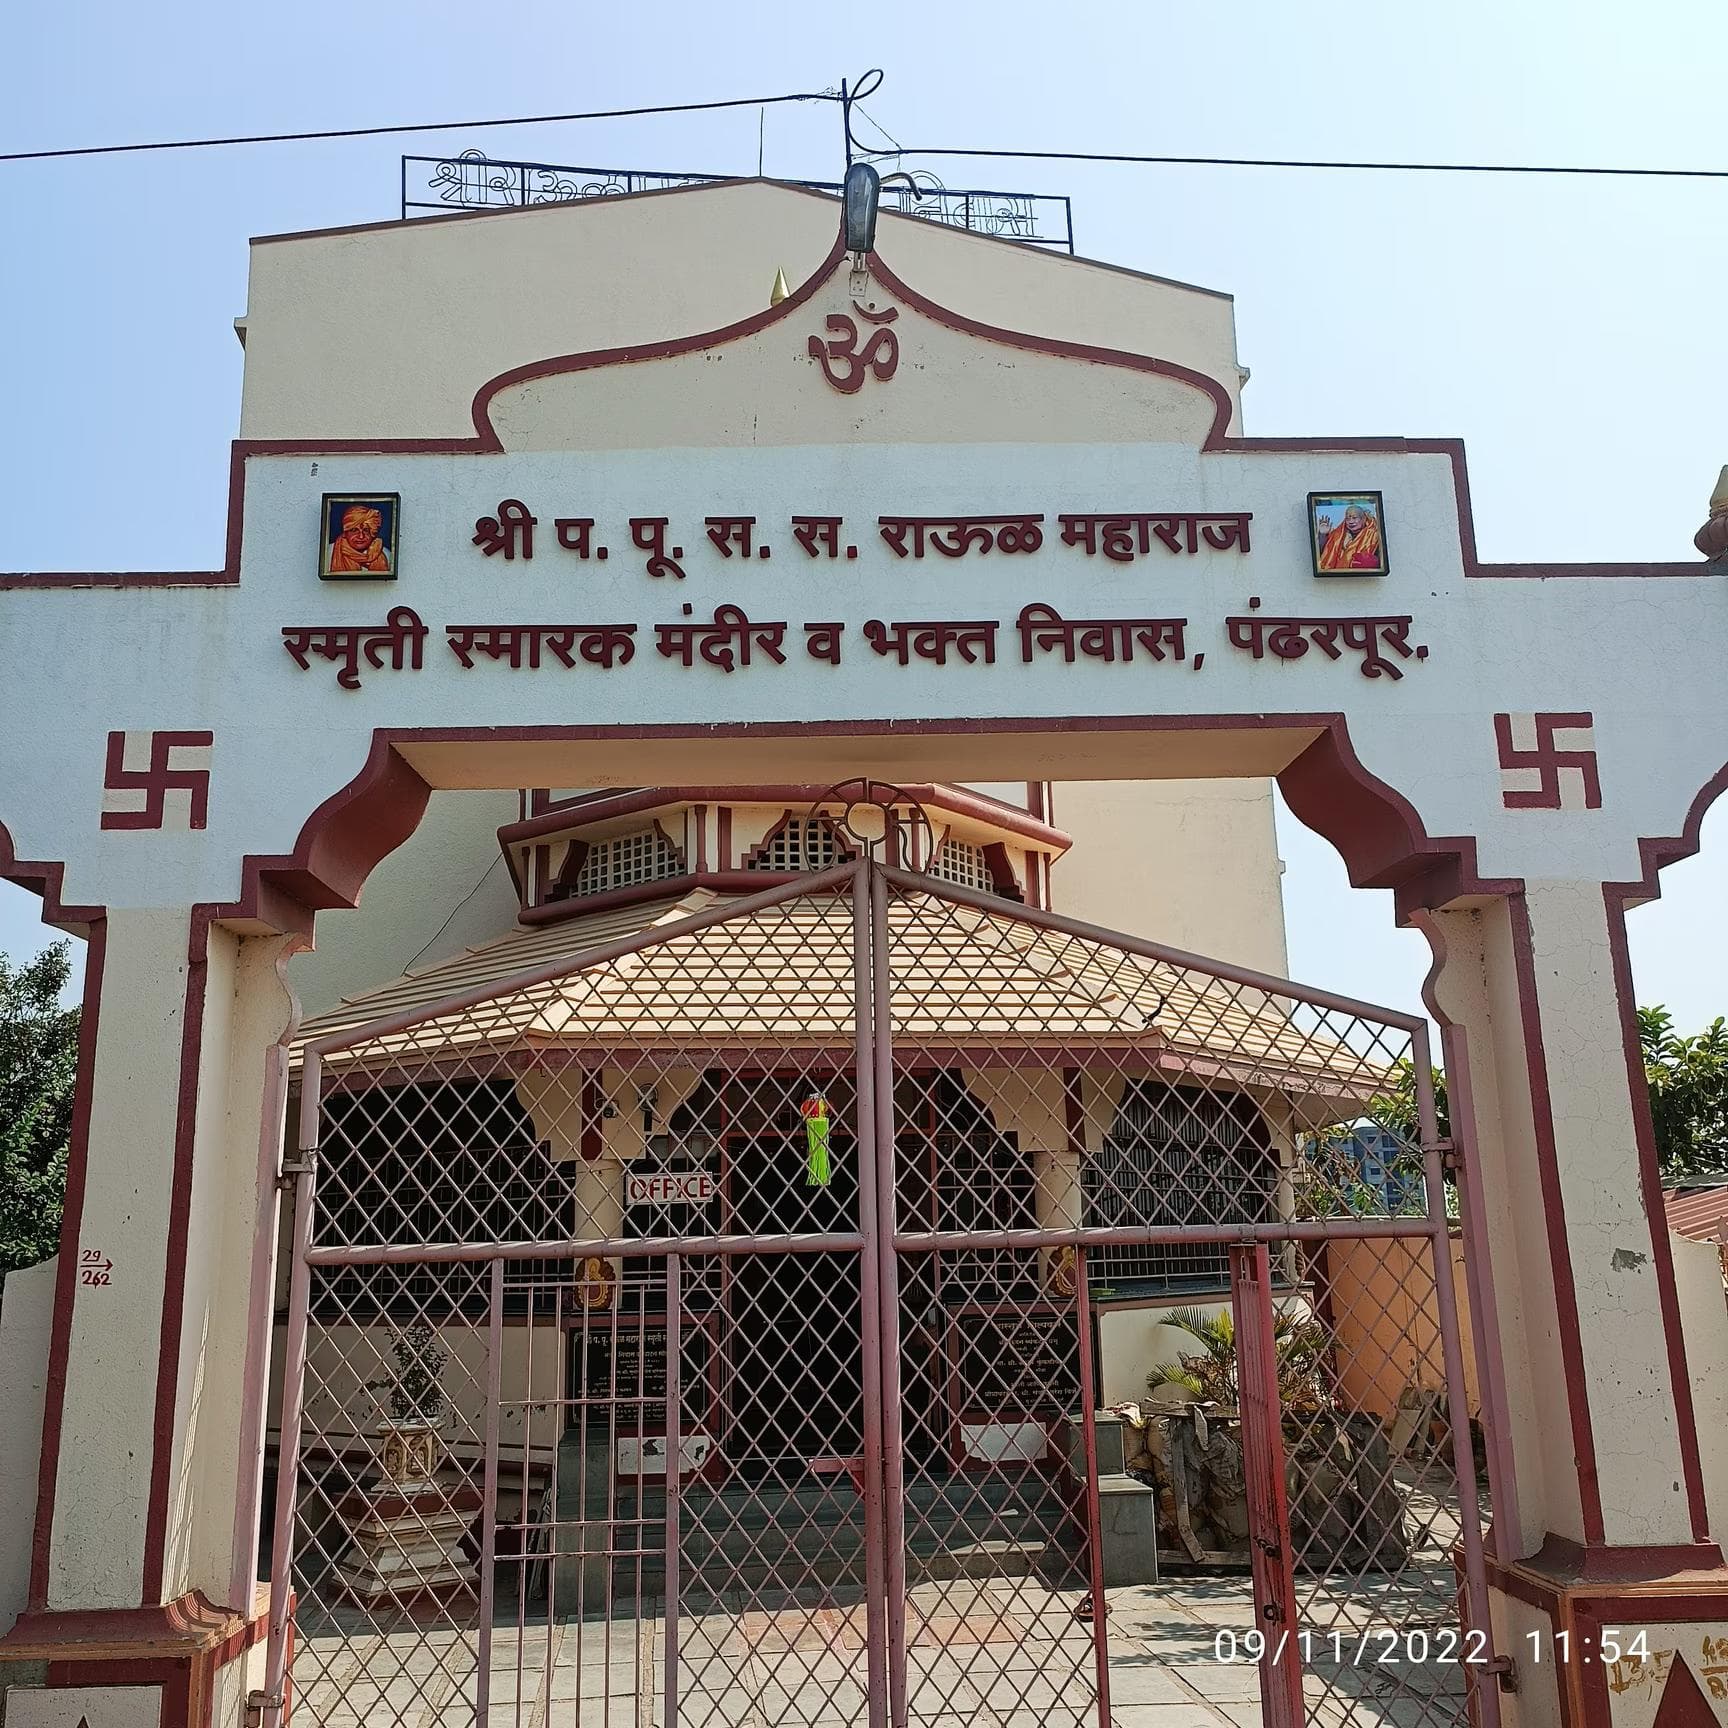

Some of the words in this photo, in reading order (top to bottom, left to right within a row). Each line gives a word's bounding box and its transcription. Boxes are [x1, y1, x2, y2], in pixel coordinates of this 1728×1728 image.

[471, 498, 538, 562] श्री
[555, 516, 609, 562] प.
[628, 516, 687, 581] पू.
[705, 516, 771, 560] स.
[792, 515, 858, 561] स.
[878, 512, 1045, 560] राऊळ
[1058, 511, 1254, 565] महाराज
[281, 605, 429, 691] स्मृती
[446, 623, 638, 671] स्मारक
[654, 602, 788, 674] मंदीर
[804, 621, 845, 667] व
[863, 619, 1000, 667] भक्त
[1016, 602, 1205, 672] निवास,
[1225, 596, 1431, 682] पंढरपूर.
[630, 1177, 711, 1200] OFFICE
[82, 1249, 102, 1262] 29
[82, 1270, 113, 1290] 262
